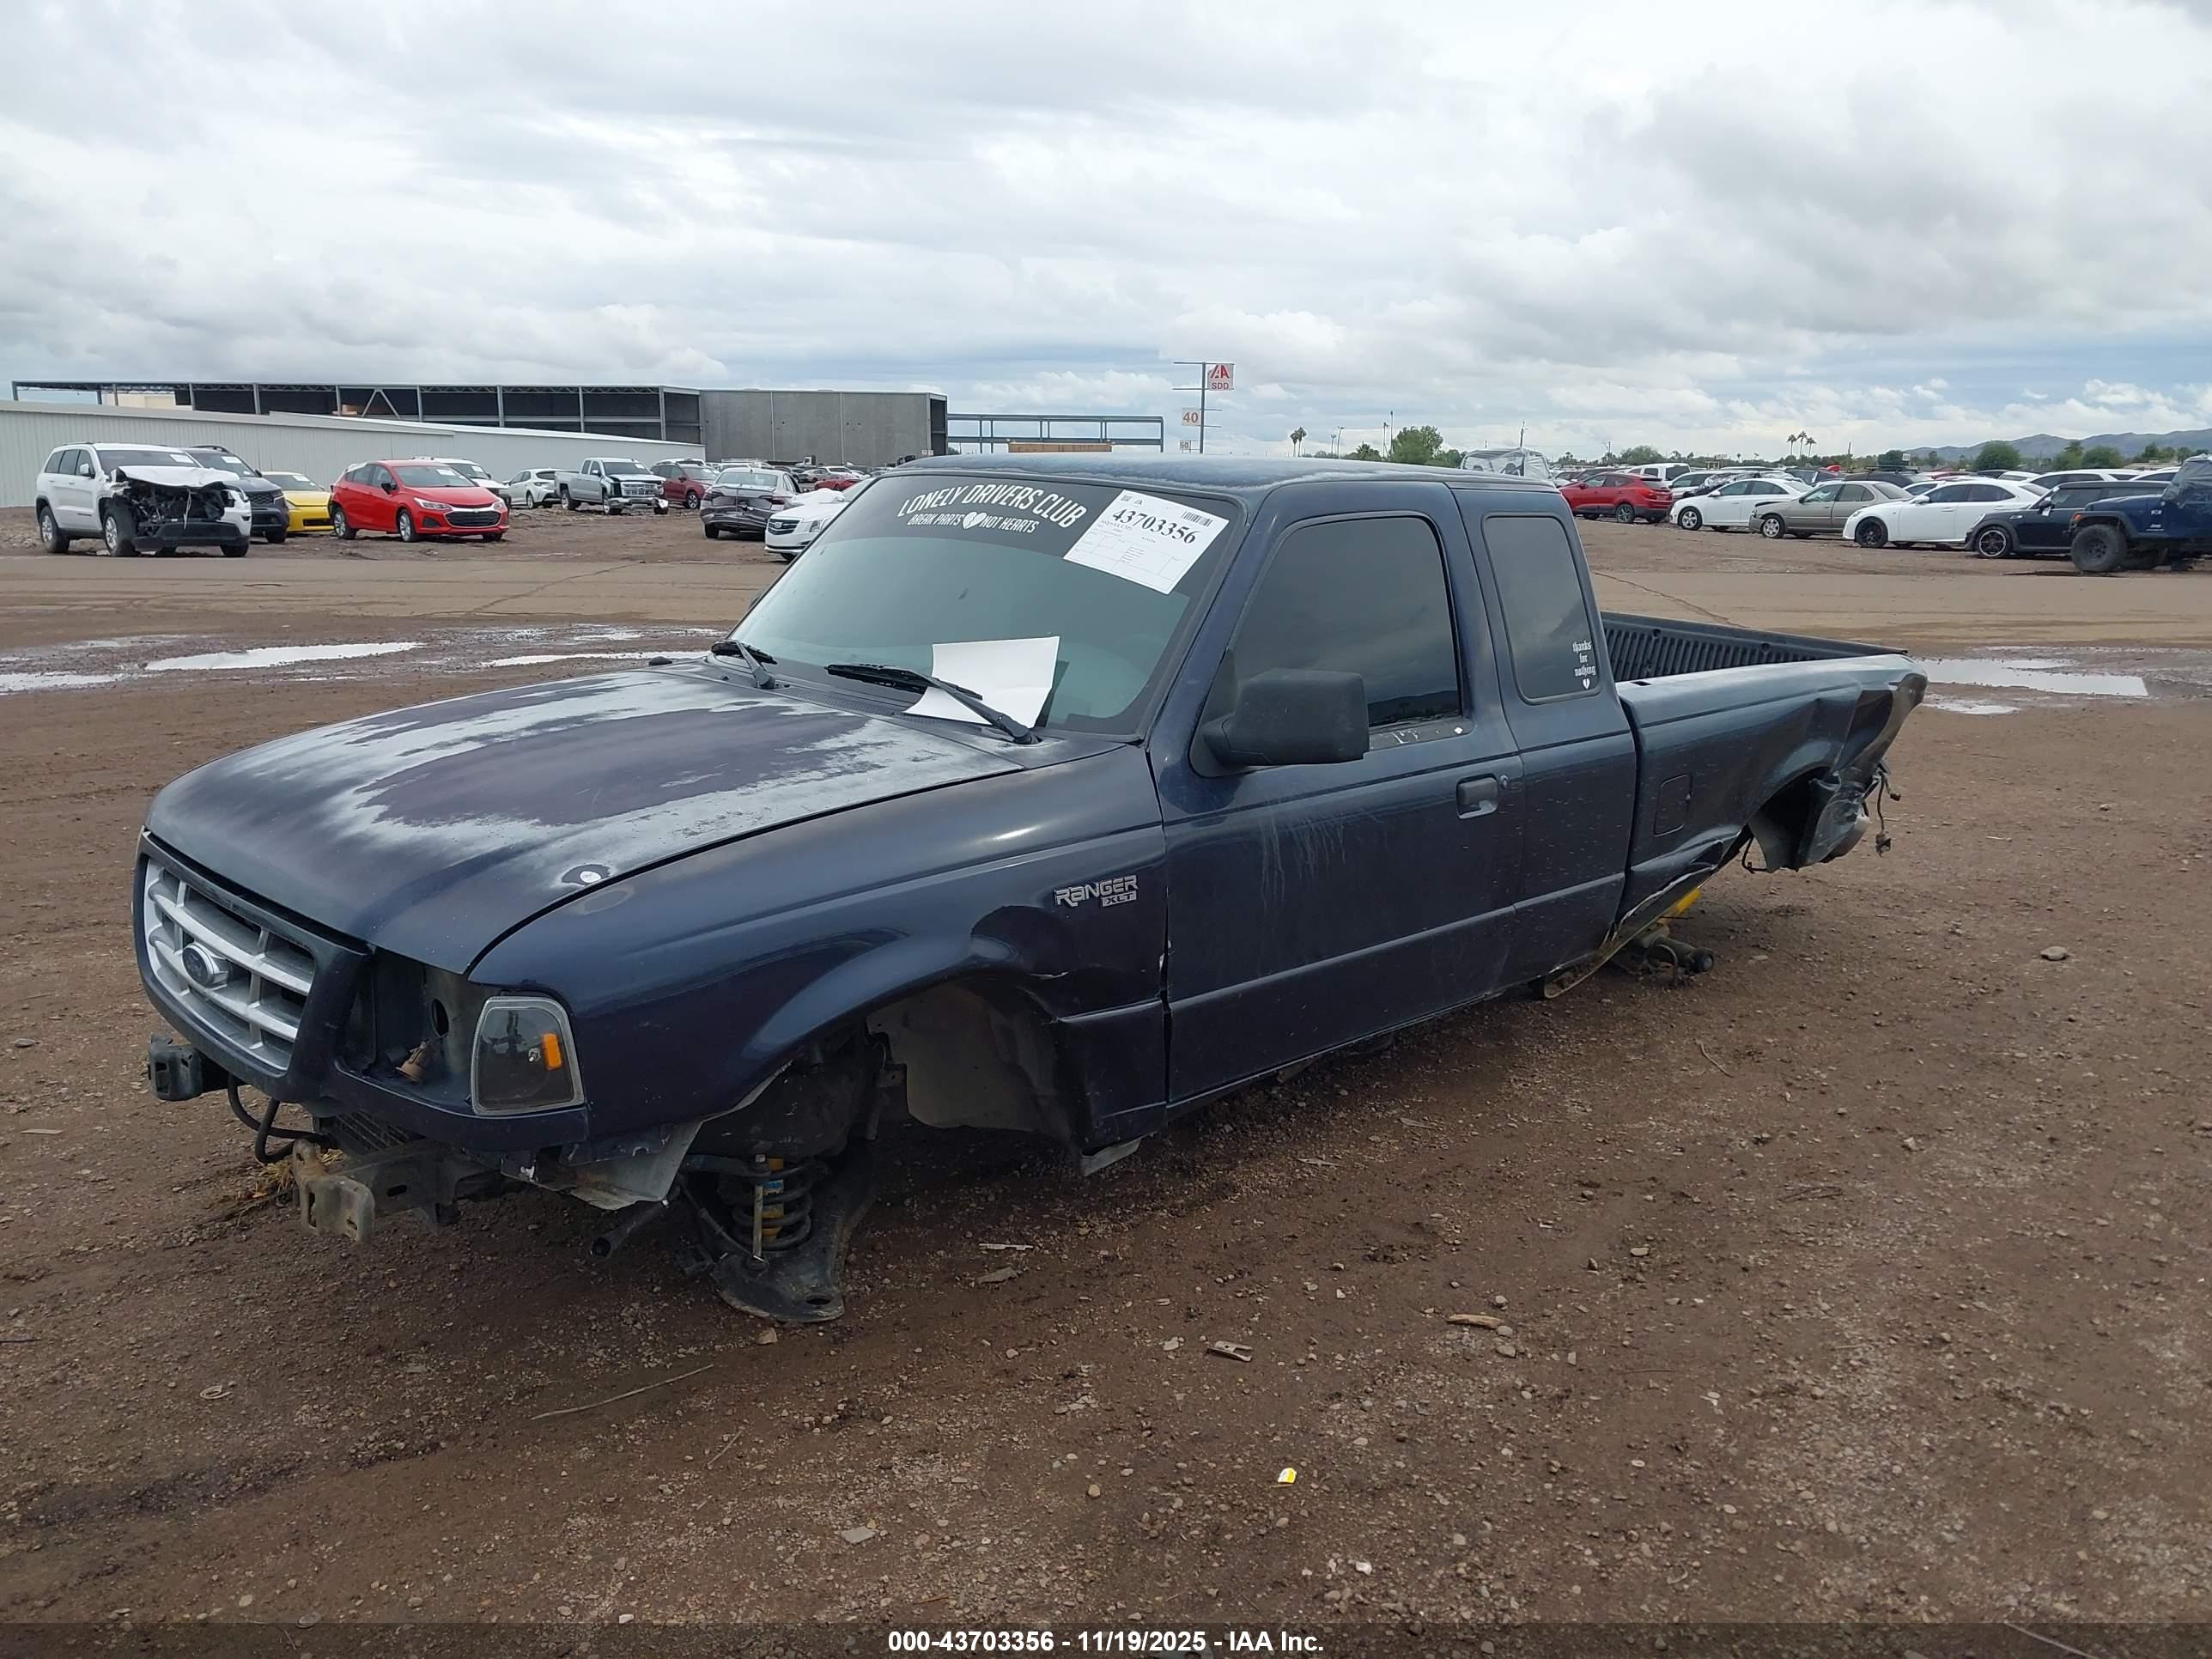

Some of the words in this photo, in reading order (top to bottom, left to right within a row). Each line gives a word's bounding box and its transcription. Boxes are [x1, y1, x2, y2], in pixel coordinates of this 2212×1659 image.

[1182, 411, 1199, 423] 40
[897, 485, 969, 517] LONELY
[961, 484, 1044, 510] DRIVERS
[1032, 494, 1087, 528] CLUB
[907, 514, 938, 526] BREAK
[937, 514, 965, 526] PARTS
[978, 514, 1003, 529] NOT
[1000, 517, 1040, 533] HEARTS
[1112, 508, 1202, 544] 43703356
[1572, 640, 1592, 653] thanks
[1579, 653, 1588, 663] for
[1574, 664, 1596, 678] nothing
[1054, 875, 1139, 907] RANGER
[1103, 892, 1134, 906] XLT
